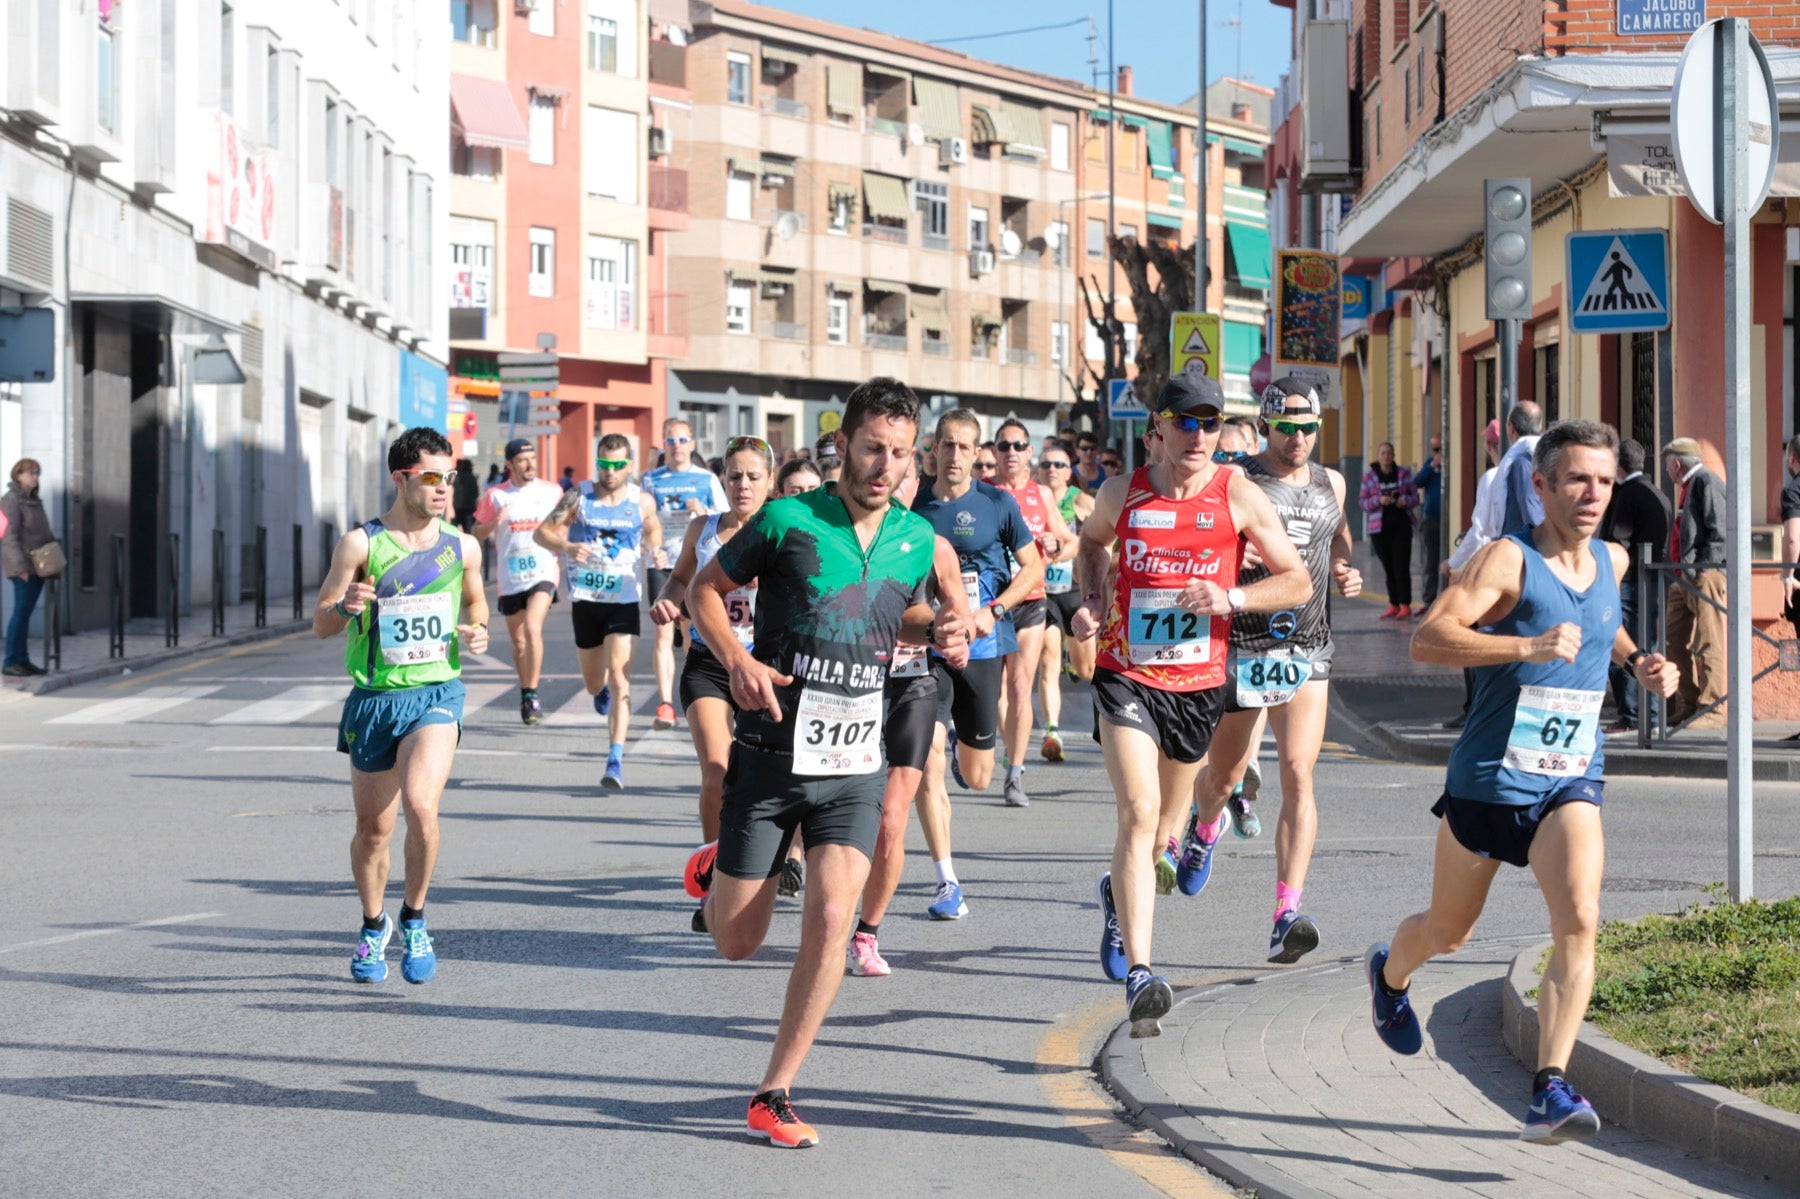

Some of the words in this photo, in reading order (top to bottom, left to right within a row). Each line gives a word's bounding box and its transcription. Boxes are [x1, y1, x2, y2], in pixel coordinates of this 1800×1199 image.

[1623, 12, 1701, 31] CAMARERO
[1189, 364, 1202, 372] 20
[586, 519, 609, 528] TODO
[611, 519, 634, 528] SUMA
[518, 556, 537, 571] 86
[1125, 538, 1221, 575] Polisalud
[584, 572, 616, 590] 995
[393, 615, 442, 643] 350
[1141, 612, 1197, 640] 712
[792, 651, 845, 686] MALA
[849, 662, 887, 689] CARA
[1250, 661, 1300, 687] 840
[806, 719, 876, 746] 3107
[1541, 716, 1581, 749] 67
